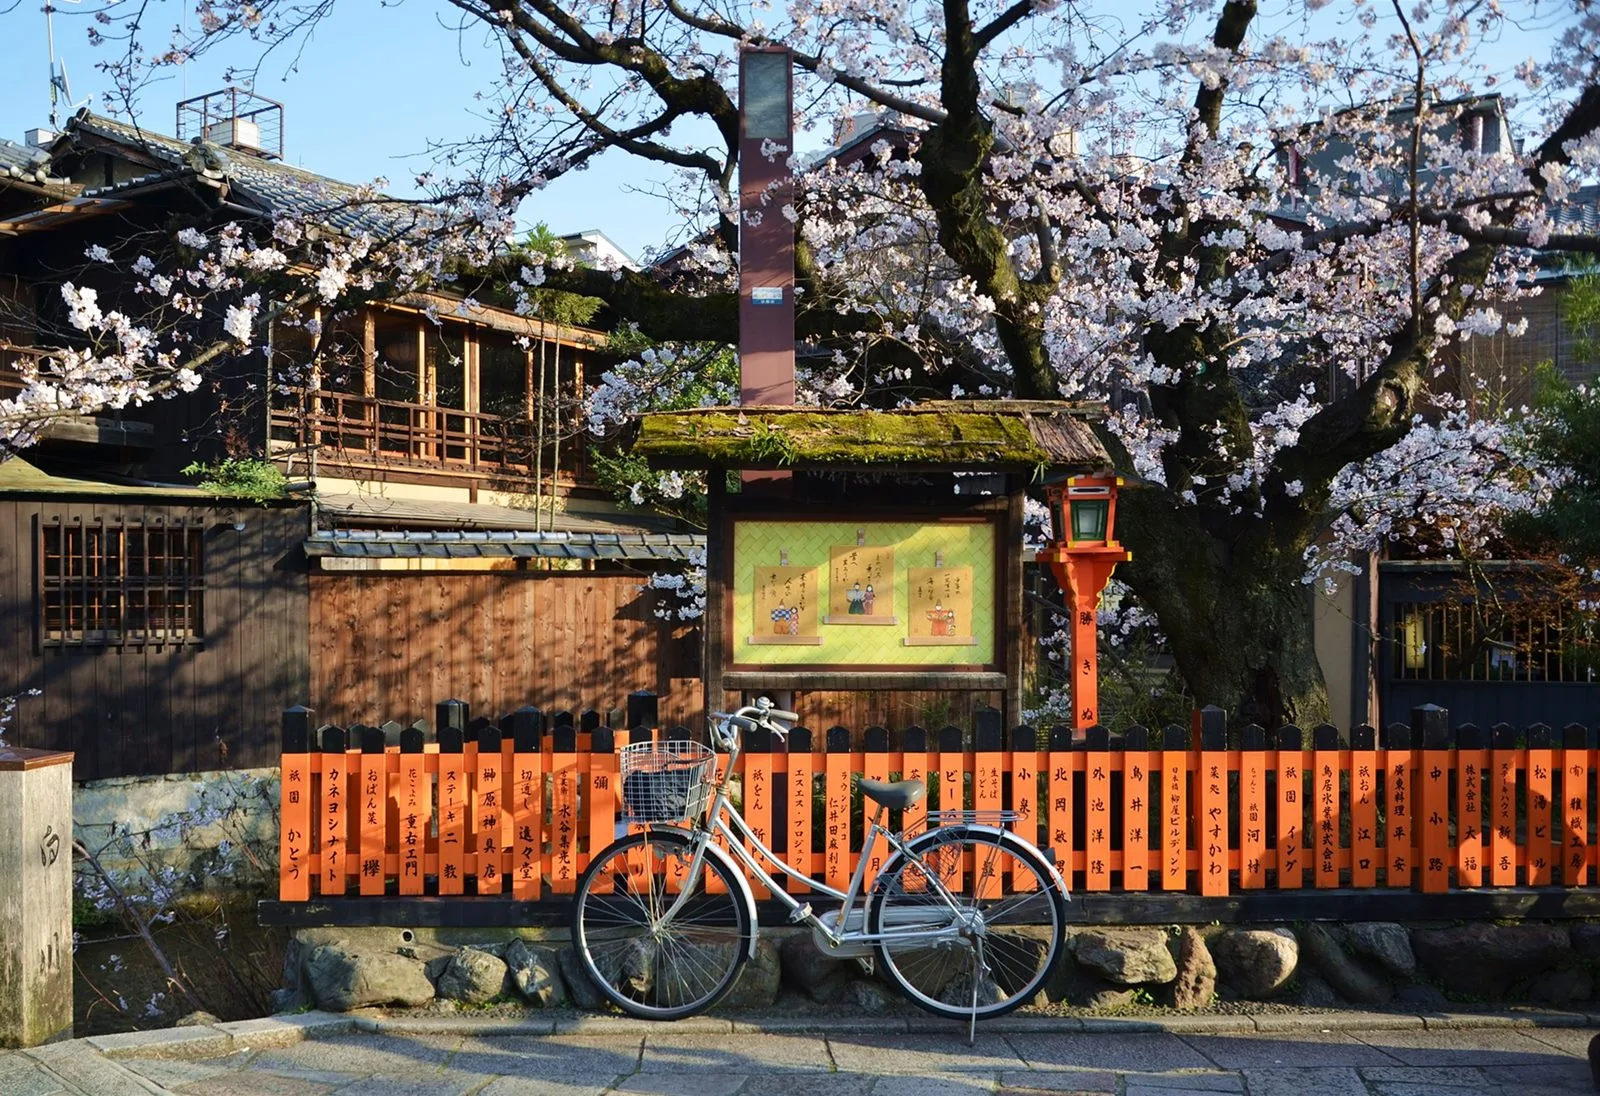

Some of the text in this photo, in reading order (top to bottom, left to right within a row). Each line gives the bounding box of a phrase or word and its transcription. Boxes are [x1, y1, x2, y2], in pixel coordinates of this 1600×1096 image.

[367, 769, 377, 824] おばん菜
[446, 771, 456, 822] ステーキ
[753, 770, 763, 809] 祇をん
[840, 772, 848, 840] ラウンジ ココ
[990, 768, 998, 798] 生そば
[1501, 764, 1510, 817] ステーキハウス
[289, 770, 301, 879] 祇園 かとう
[328, 769, 339, 881] カネヨシナイト
[1209, 808, 1221, 875] やすかわ
[1286, 767, 1297, 872] 祇園 イング
[1358, 766, 1371, 869] 祇おん 江口
[1394, 826, 1405, 871] 平安
[1429, 766, 1443, 871] 中小路
[1464, 764, 1477, 871] 株式会社 大福
